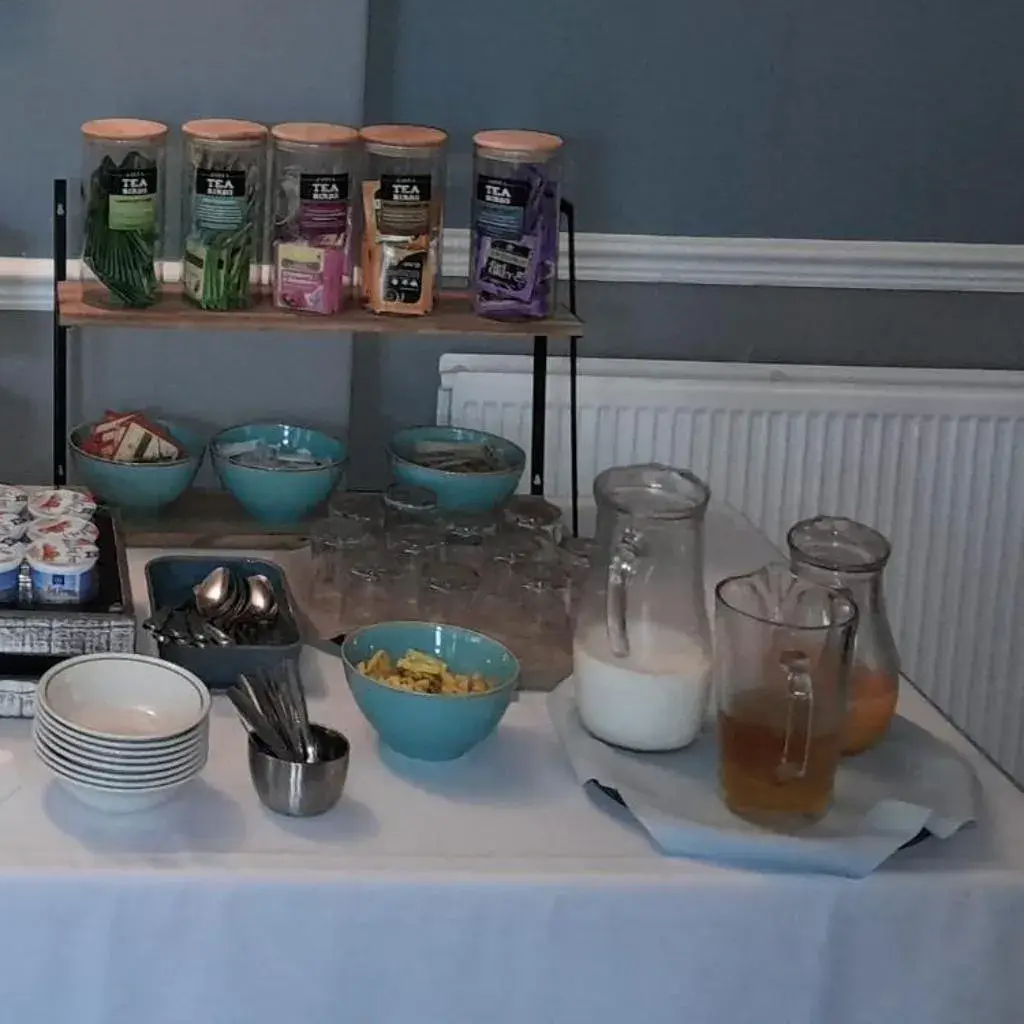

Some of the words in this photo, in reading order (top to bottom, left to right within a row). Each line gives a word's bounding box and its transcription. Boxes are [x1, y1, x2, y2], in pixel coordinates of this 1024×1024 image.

[121, 178, 148, 188] TEA
[206, 178, 234, 189] TEA
[312, 183, 339, 193] TEA
[392, 184, 420, 194] TEA
[485, 185, 512, 198] TEA
